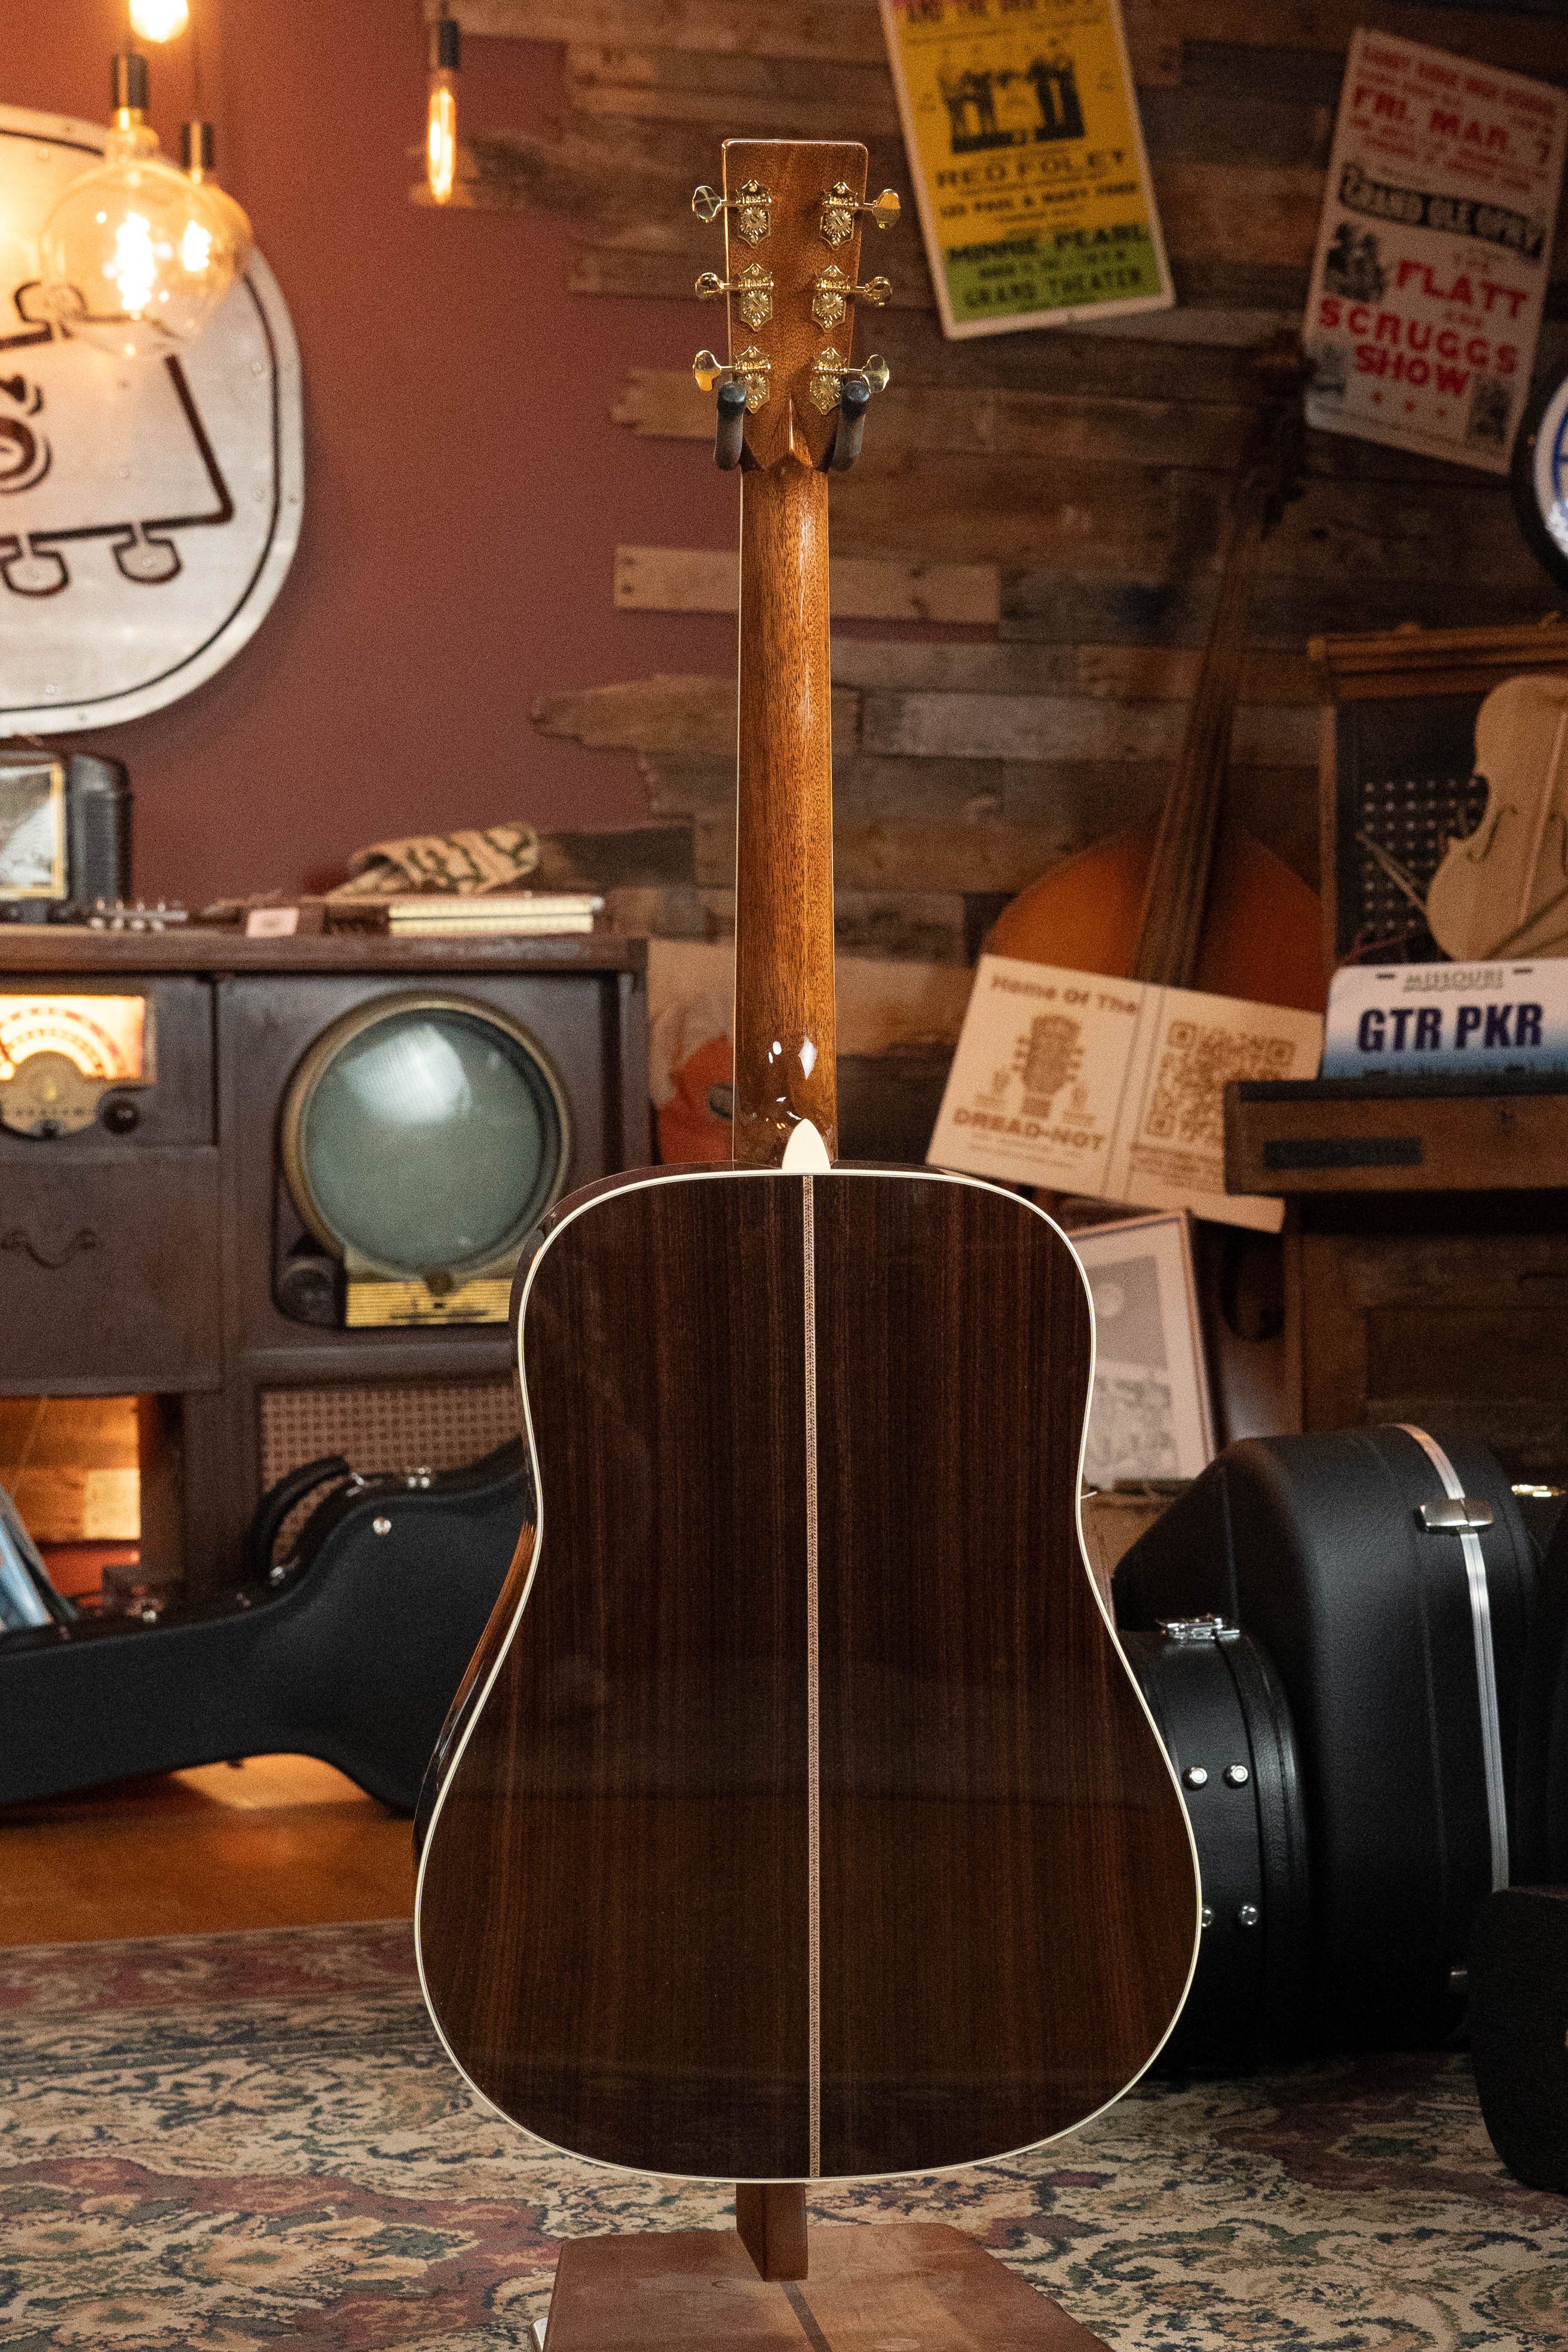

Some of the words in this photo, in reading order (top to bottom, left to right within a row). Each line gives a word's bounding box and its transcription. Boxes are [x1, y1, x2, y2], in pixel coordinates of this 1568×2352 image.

[1396, 259, 1529, 319] FLATT
[1318, 298, 1519, 375] SCRUGGS
[1355, 343, 1471, 396] SHOW
[991, 975, 1059, 1002] Home
[1098, 993, 1140, 1015] The
[1403, 968, 1503, 993] MISSOURI
[1357, 1007, 1443, 1052] GTR
[1454, 1003, 1544, 1050] PKR
[952, 1107, 1107, 1152] DREAD-NOT
